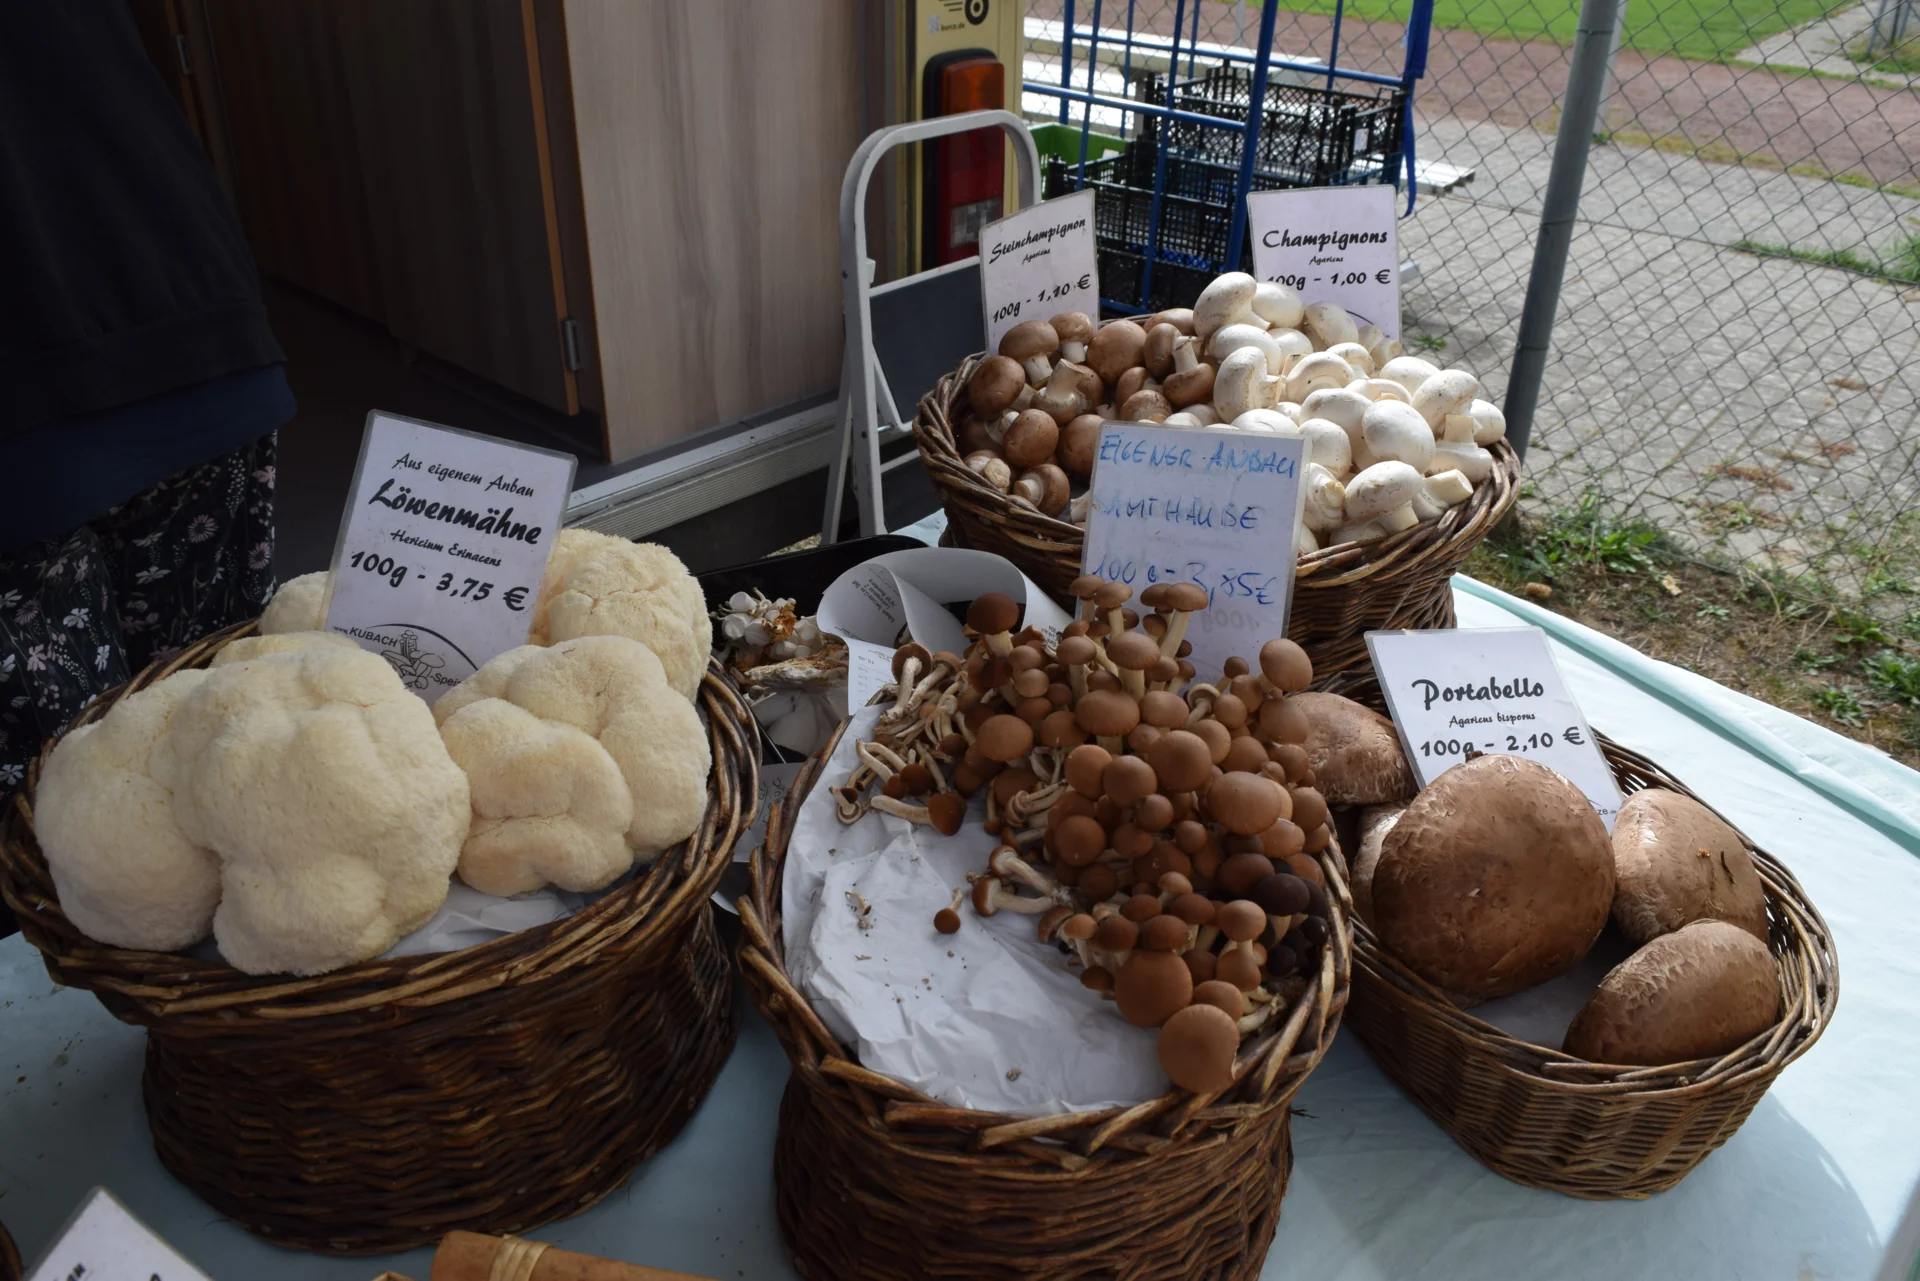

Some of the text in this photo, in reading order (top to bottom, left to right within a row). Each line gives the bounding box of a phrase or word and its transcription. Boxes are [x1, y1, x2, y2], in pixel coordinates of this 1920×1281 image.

[989, 218, 1085, 264] Steinchampignon
[1262, 229, 1388, 252] Champignons
[1308, 256, 1344, 266] Agaricus
[1330, 272, 1367, 286] 1,00
[1375, 269, 1391, 284] €
[993, 301, 1021, 323] 100g
[1038, 283, 1070, 302] 1,10
[1077, 274, 1091, 290] €
[1100, 432, 1296, 479] EIGENER ANBAU
[392, 453, 534, 497] Aus eigenem Anbau
[368, 479, 542, 544] Löwenmähne
[390, 529, 443, 552] Hericium
[351, 551, 408, 588] 100g
[436, 572, 494, 601] 3,75
[503, 586, 529, 611] €
[1411, 676, 1544, 711] Portabello
[1449, 712, 1536, 728] Agaricus bisporus
[1506, 732, 1553, 751] 2,10
[1562, 726, 1585, 746] €
